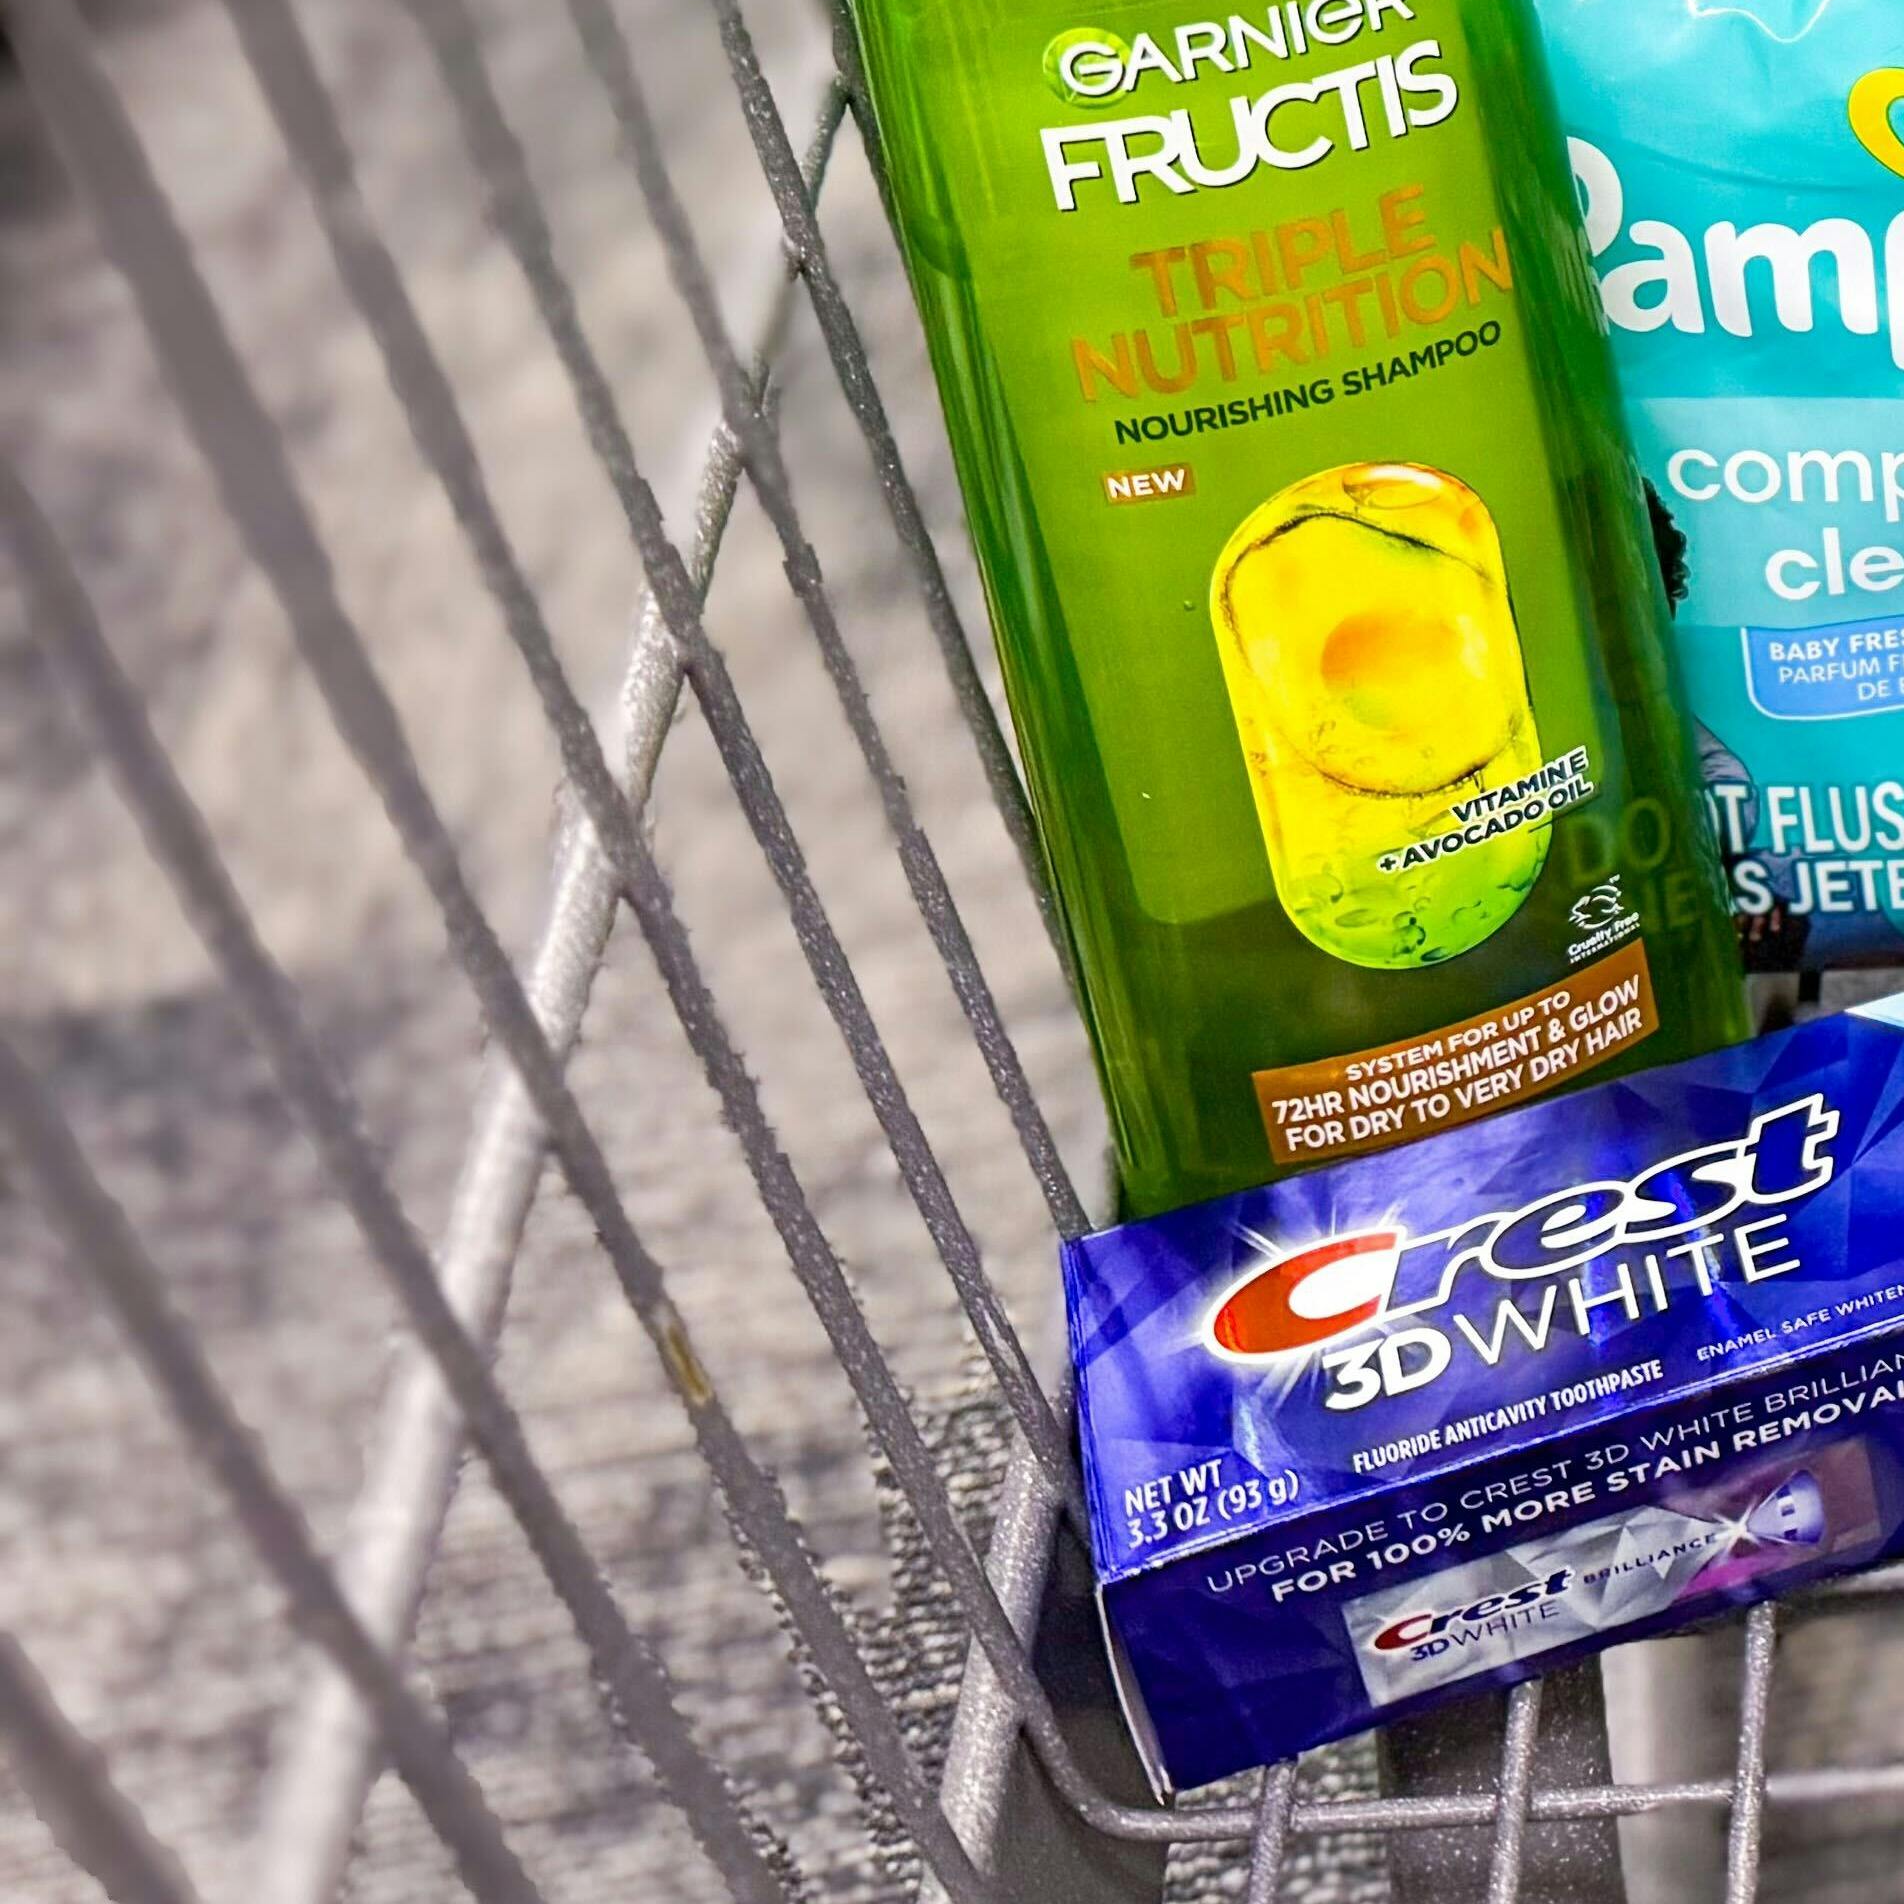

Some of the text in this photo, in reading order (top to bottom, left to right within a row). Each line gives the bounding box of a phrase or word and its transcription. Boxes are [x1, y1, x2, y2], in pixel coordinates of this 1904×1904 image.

[1040, 39, 1459, 212] FRUCTIS
[1130, 184, 1438, 319] TRIPLE
[1072, 253, 1513, 403] NUTRITION
[1114, 320, 1502, 445] NOURISHING SHAMPOO
[1107, 470, 1185, 498] NEW
[1402, 801, 1545, 869] AVOCADO
[1547, 779, 1593, 811] OIL
[1453, 751, 1587, 822] VITAMINE
[1272, 974, 1639, 1124] 72HR NOURISHMENT & GLOW
[1286, 1009, 1642, 1151] FOR DRY TO VERY DRY HAIR
[1346, 991, 1570, 1081] SYSTEM FOR UP TO
[1203, 1092, 1841, 1364] Crest
[1354, 1359, 1664, 1475] FLUORIDE ANTICAVITY TOOTHPASTE
[1125, 1459, 1224, 1517] NET WT
[1125, 1466, 1300, 1549] 3.3 OZ (93 g)
[1206, 1519, 1389, 1594] UPGRADE
[1397, 1496, 1449, 1532] TO
[1460, 1463, 1572, 1512] CREST
[1586, 1442, 1630, 1475] 3D
[1639, 1402, 1753, 1458] WHITE
[1272, 1560, 1356, 1604] FOR
[1364, 1523, 1470, 1573] 100%
[1480, 1482, 1597, 1535] MORE
[1607, 1440, 1722, 1493] STAIN
